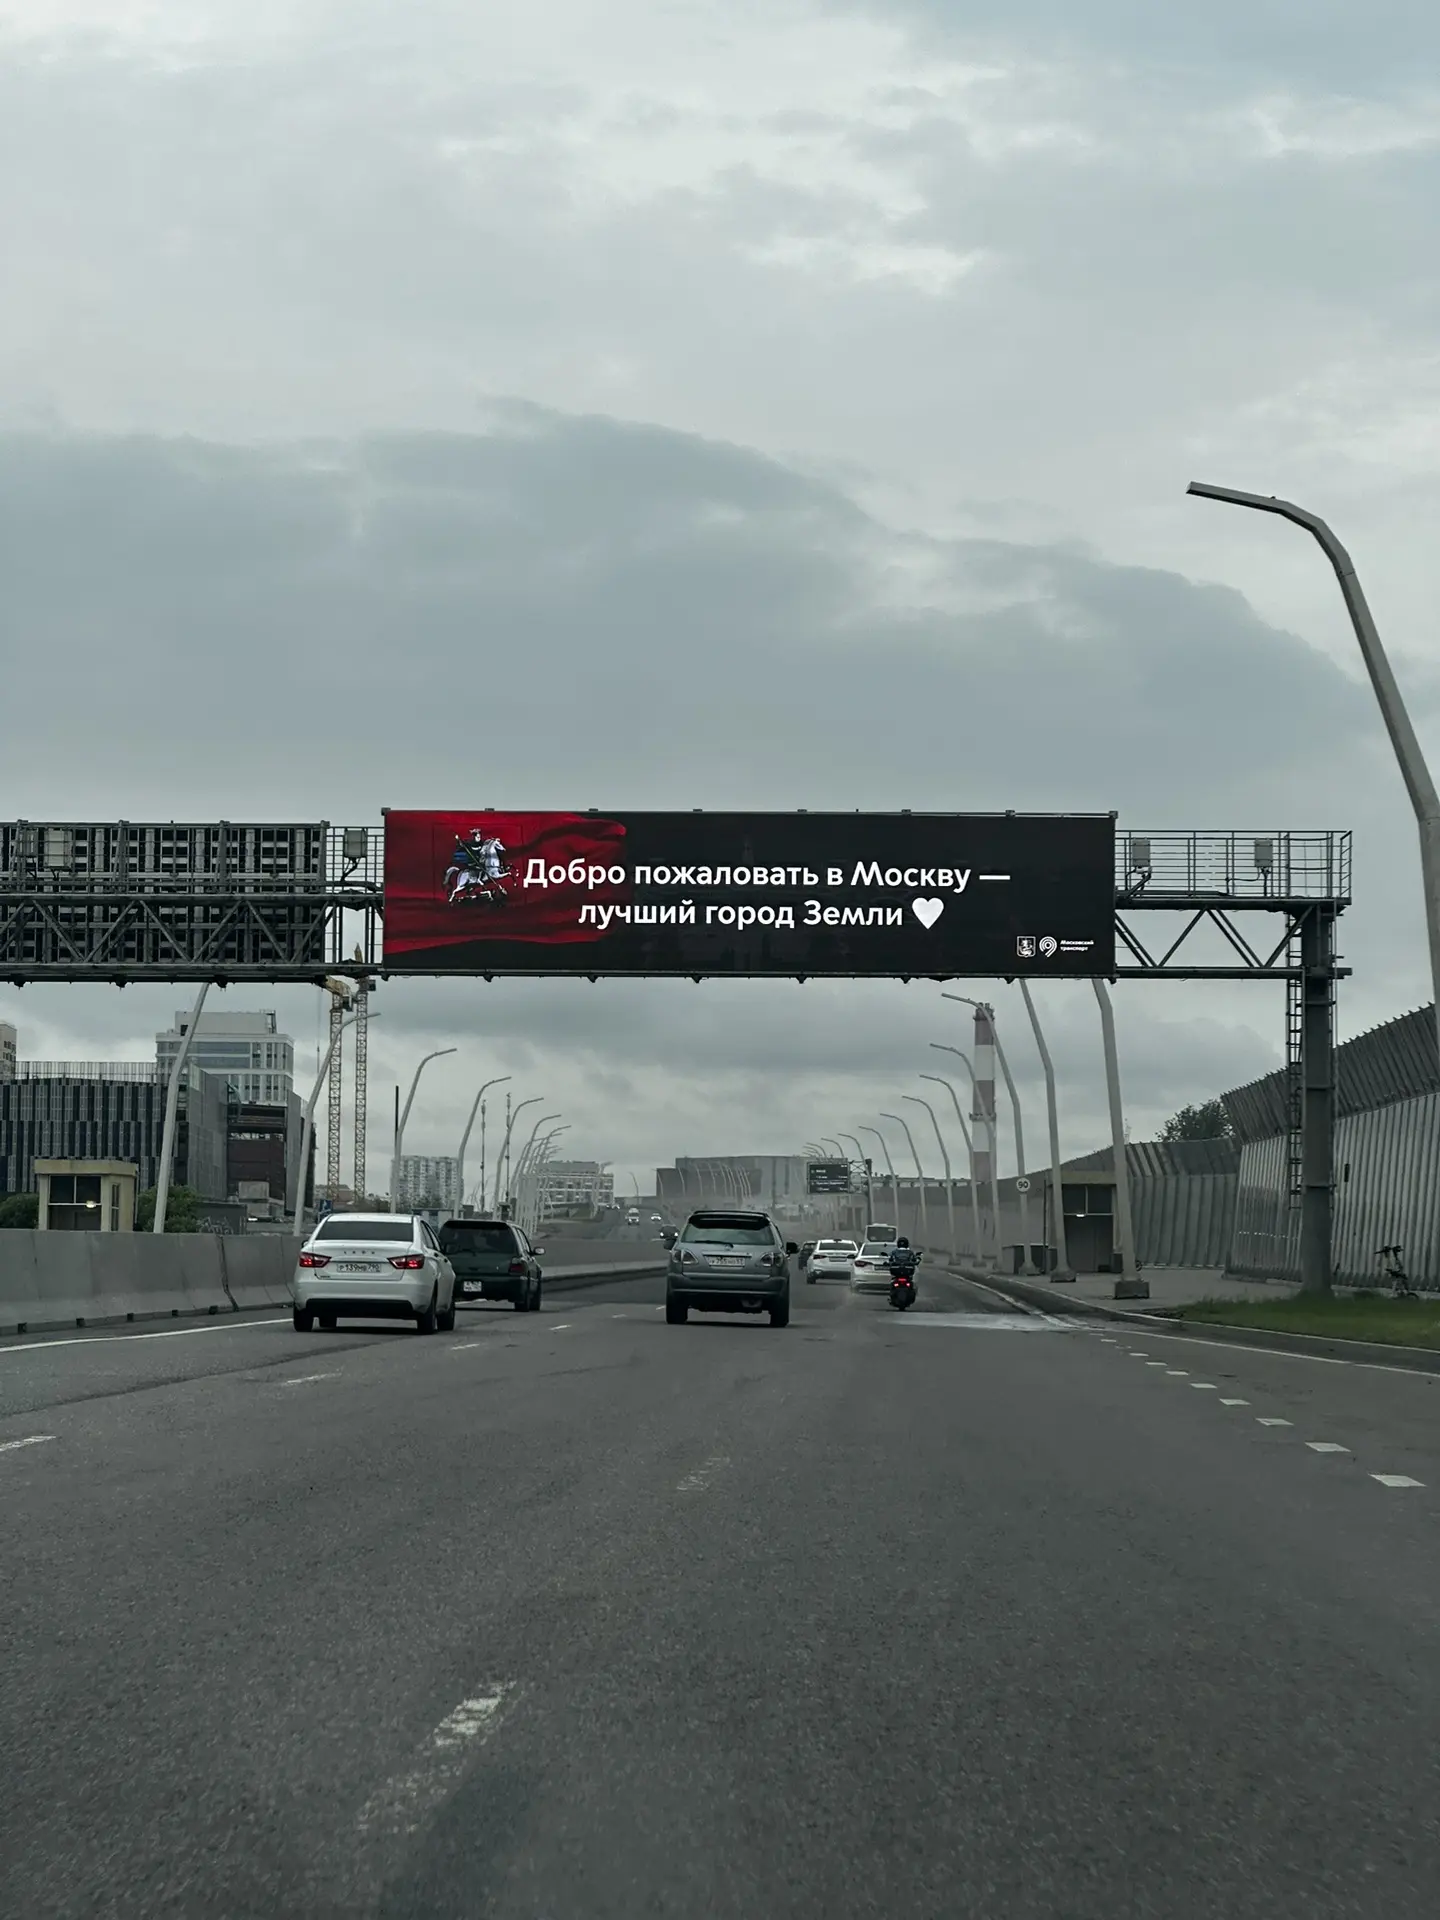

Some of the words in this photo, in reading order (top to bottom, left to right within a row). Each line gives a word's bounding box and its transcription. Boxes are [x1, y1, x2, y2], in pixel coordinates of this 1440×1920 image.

[522, 857, 626, 890] Добро
[634, 865, 819, 886] пожаловать
[827, 867, 844, 886] в
[850, 861, 972, 894] Москву
[578, 899, 696, 930] лучший
[705, 905, 795, 931] город
[802, 899, 903, 926] Земли
[1017, 1180, 1029, 1189] 90
